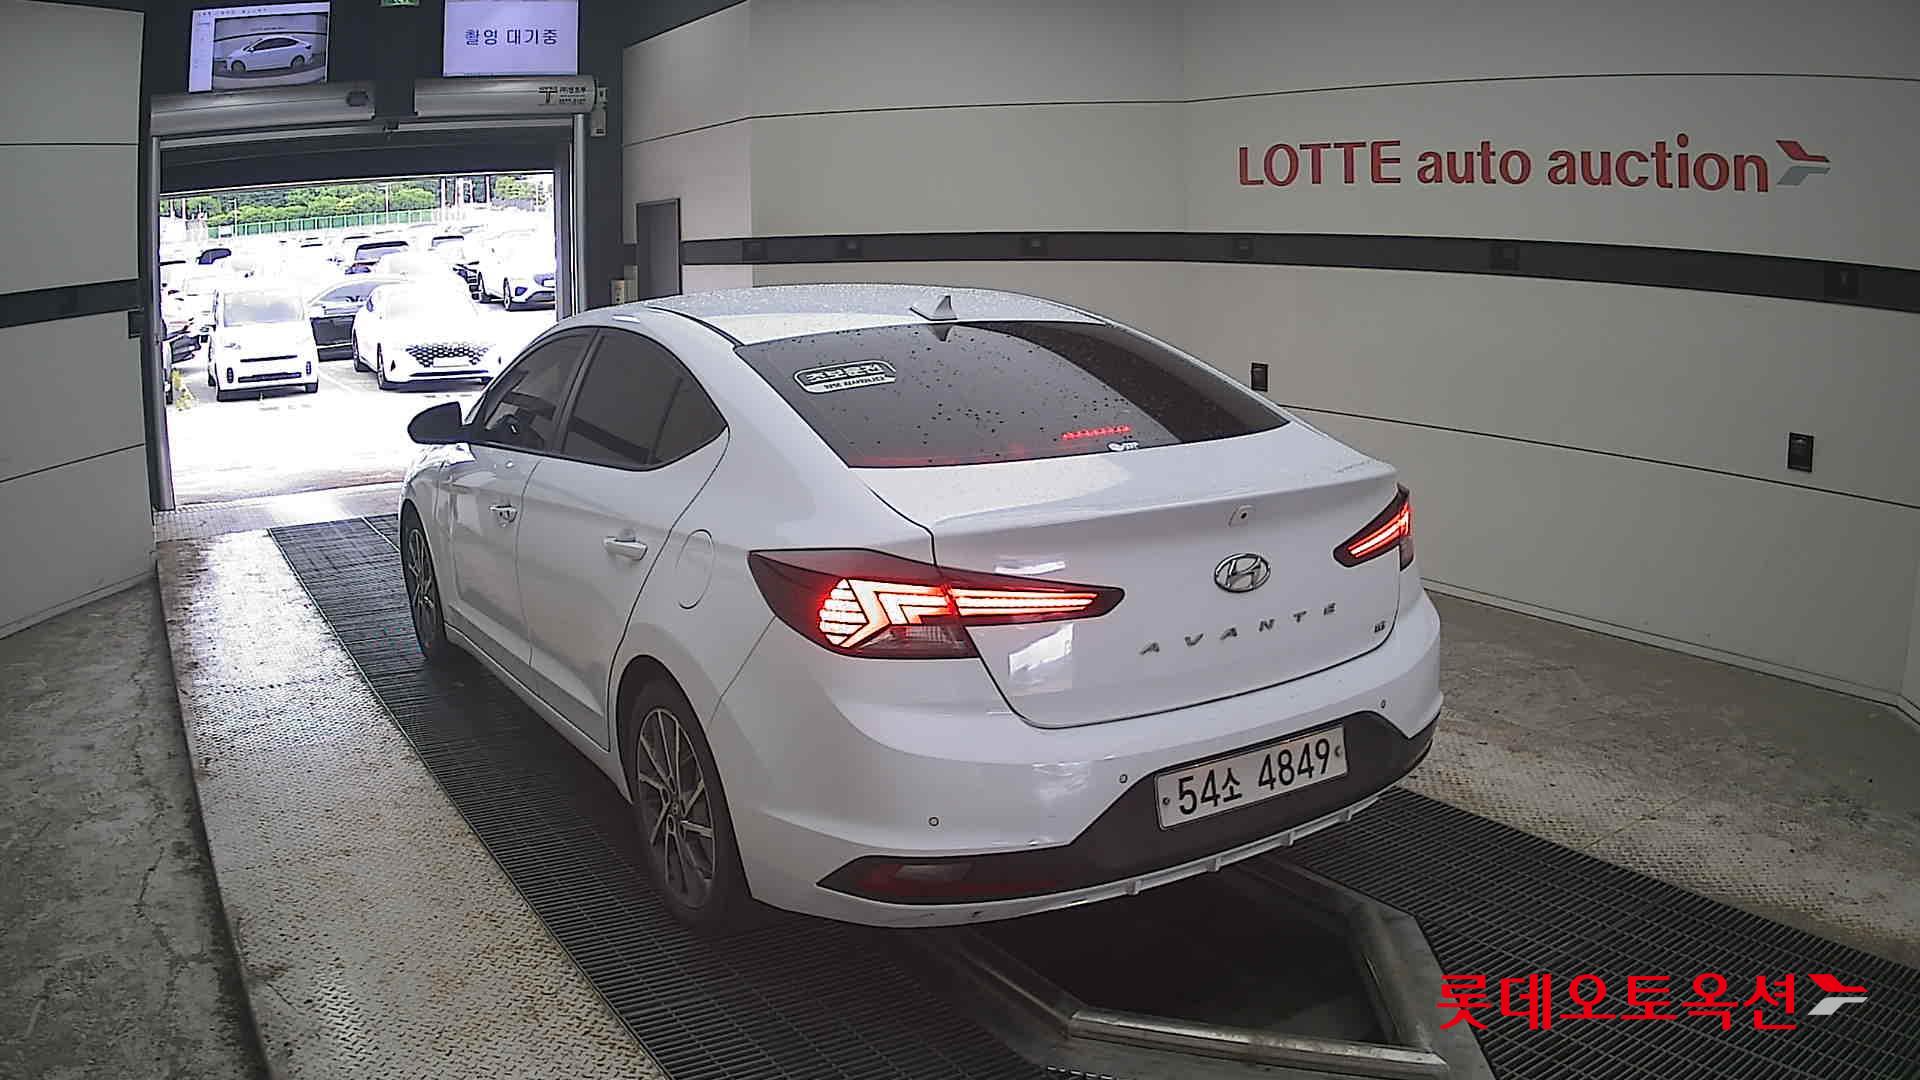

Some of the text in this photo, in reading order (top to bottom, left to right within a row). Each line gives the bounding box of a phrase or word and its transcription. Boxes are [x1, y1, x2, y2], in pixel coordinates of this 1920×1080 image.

[465, 28, 558, 46] 촬영 대기중
[1239, 133, 1769, 192] LOTTE auto auction
[1139, 602, 1336, 655] AVANTE
[1178, 738, 1331, 815] 54소 4849
